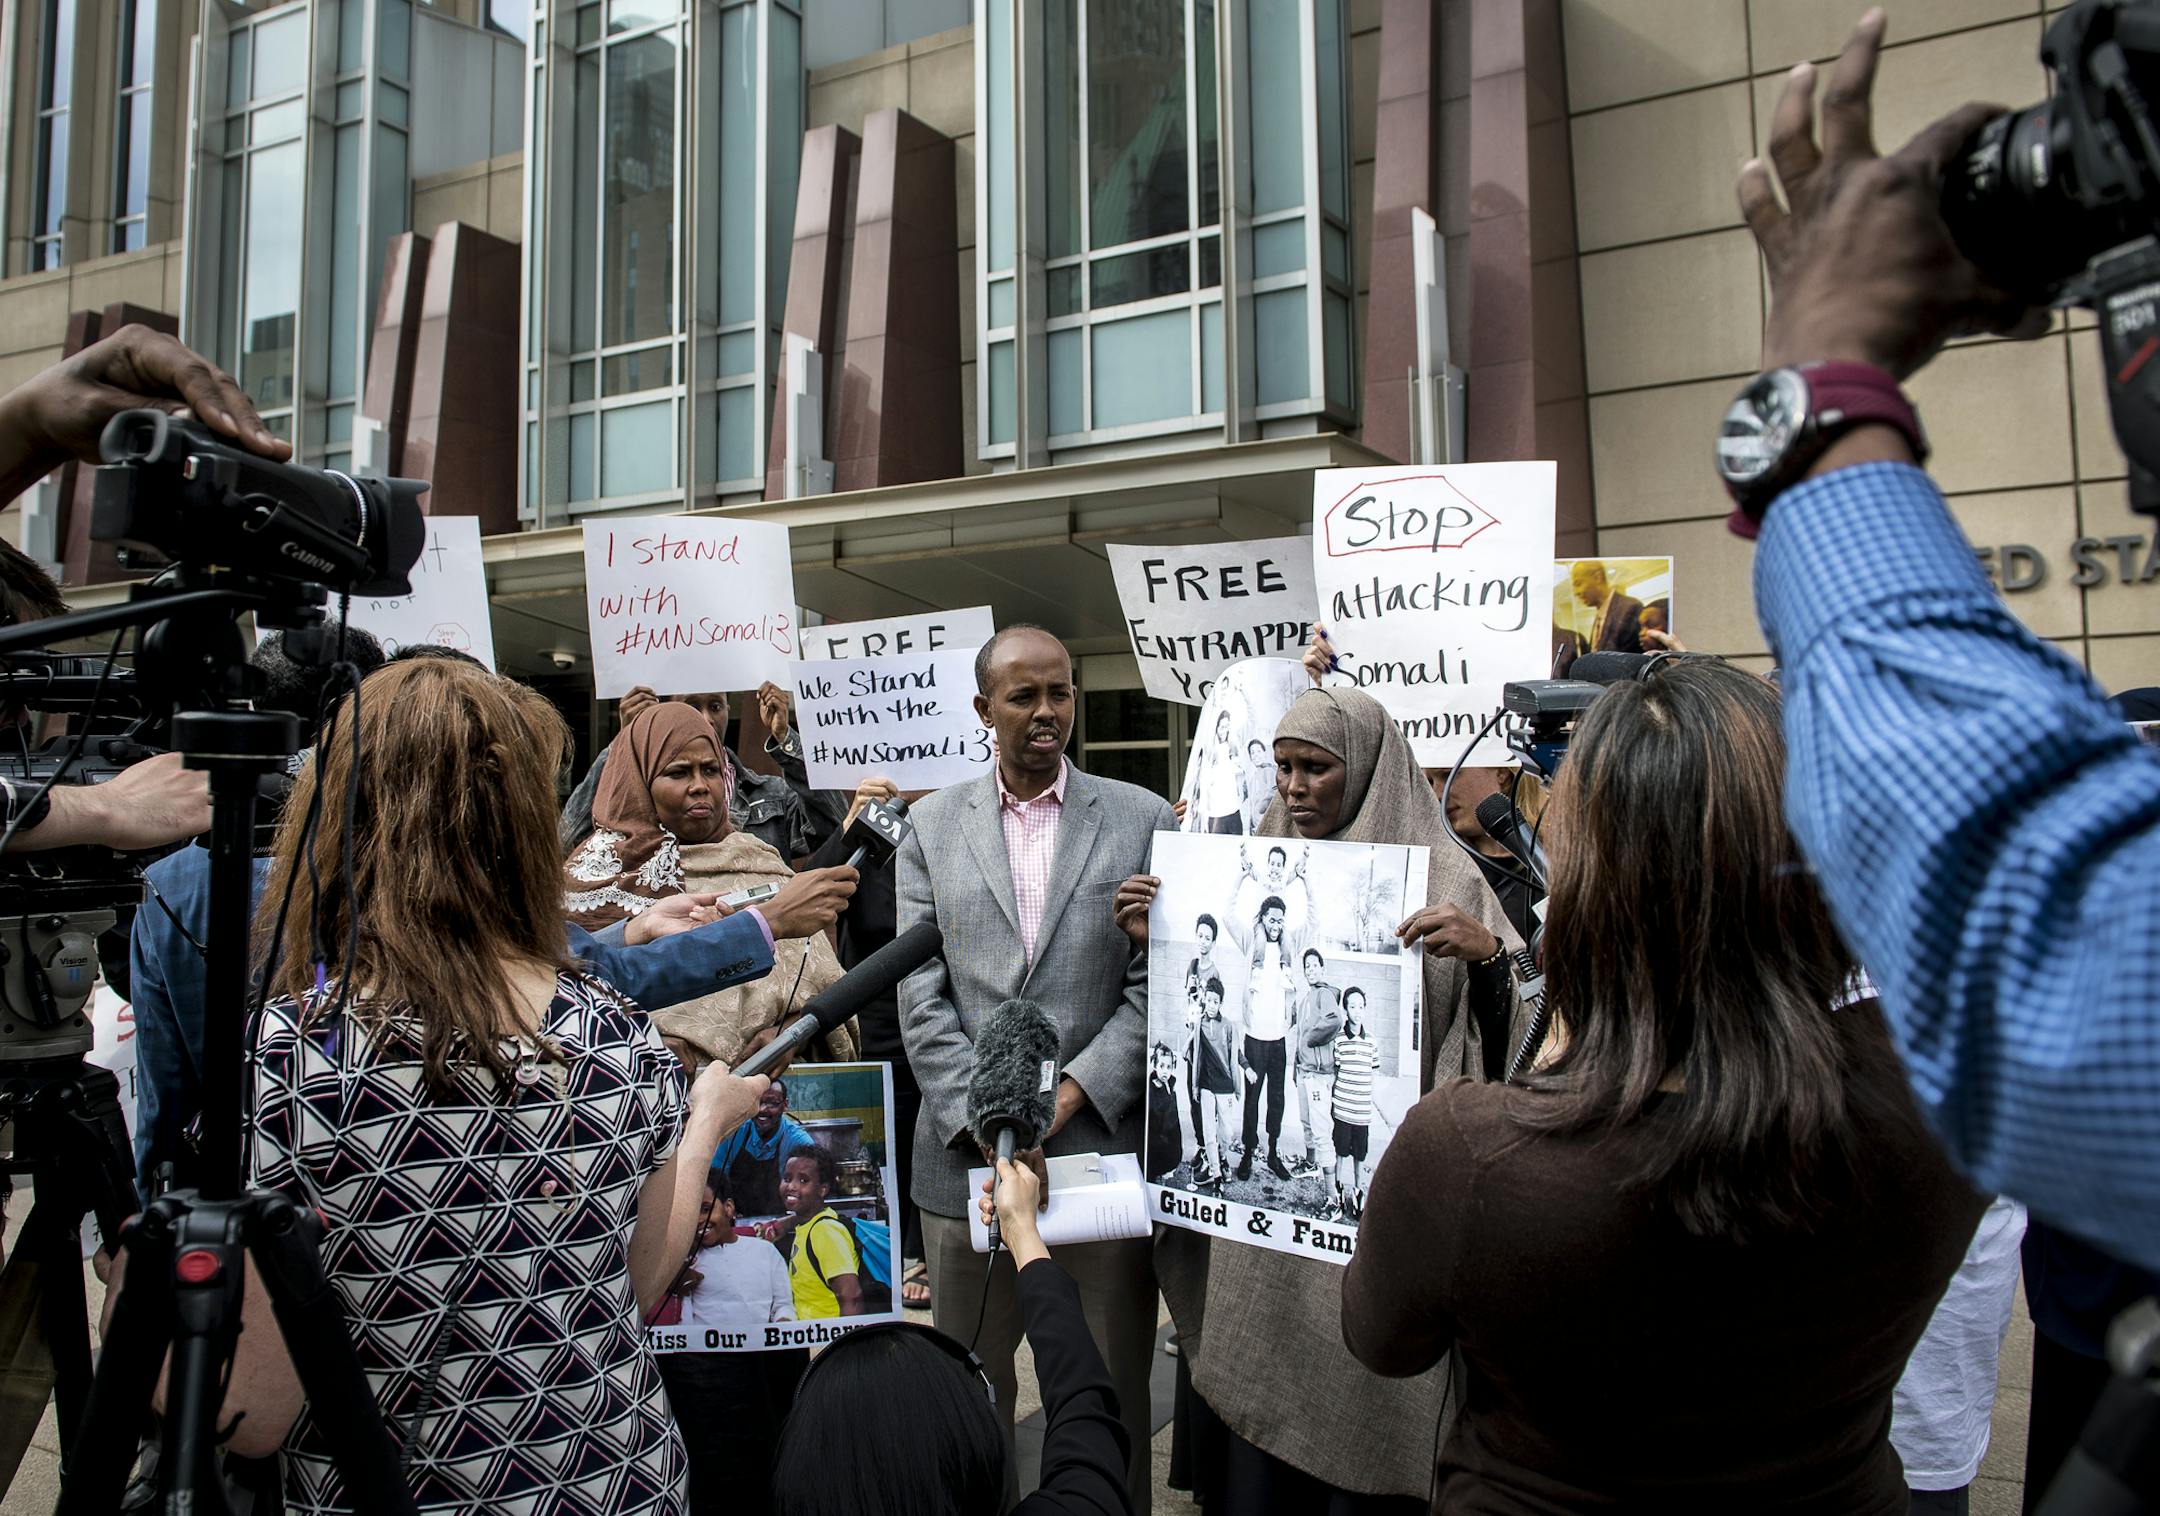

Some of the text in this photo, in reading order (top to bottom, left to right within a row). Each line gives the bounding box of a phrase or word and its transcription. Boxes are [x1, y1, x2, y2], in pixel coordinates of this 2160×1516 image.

[1346, 496, 1473, 553] Stop
[281, 541, 335, 573] Canon
[1142, 559, 1287, 603] FREE
[1333, 569, 1528, 632] attacking
[600, 585, 677, 618] with
[1332, 647, 1469, 688] Somali
[799, 676, 839, 700] We
[816, 697, 943, 727] with the
[867, 802, 902, 841] VOA
[1160, 1190, 1228, 1228] Guled
[1247, 1211, 1273, 1238] &
[1292, 1219, 1358, 1255] Fam
[705, 1328, 747, 1349] Our
